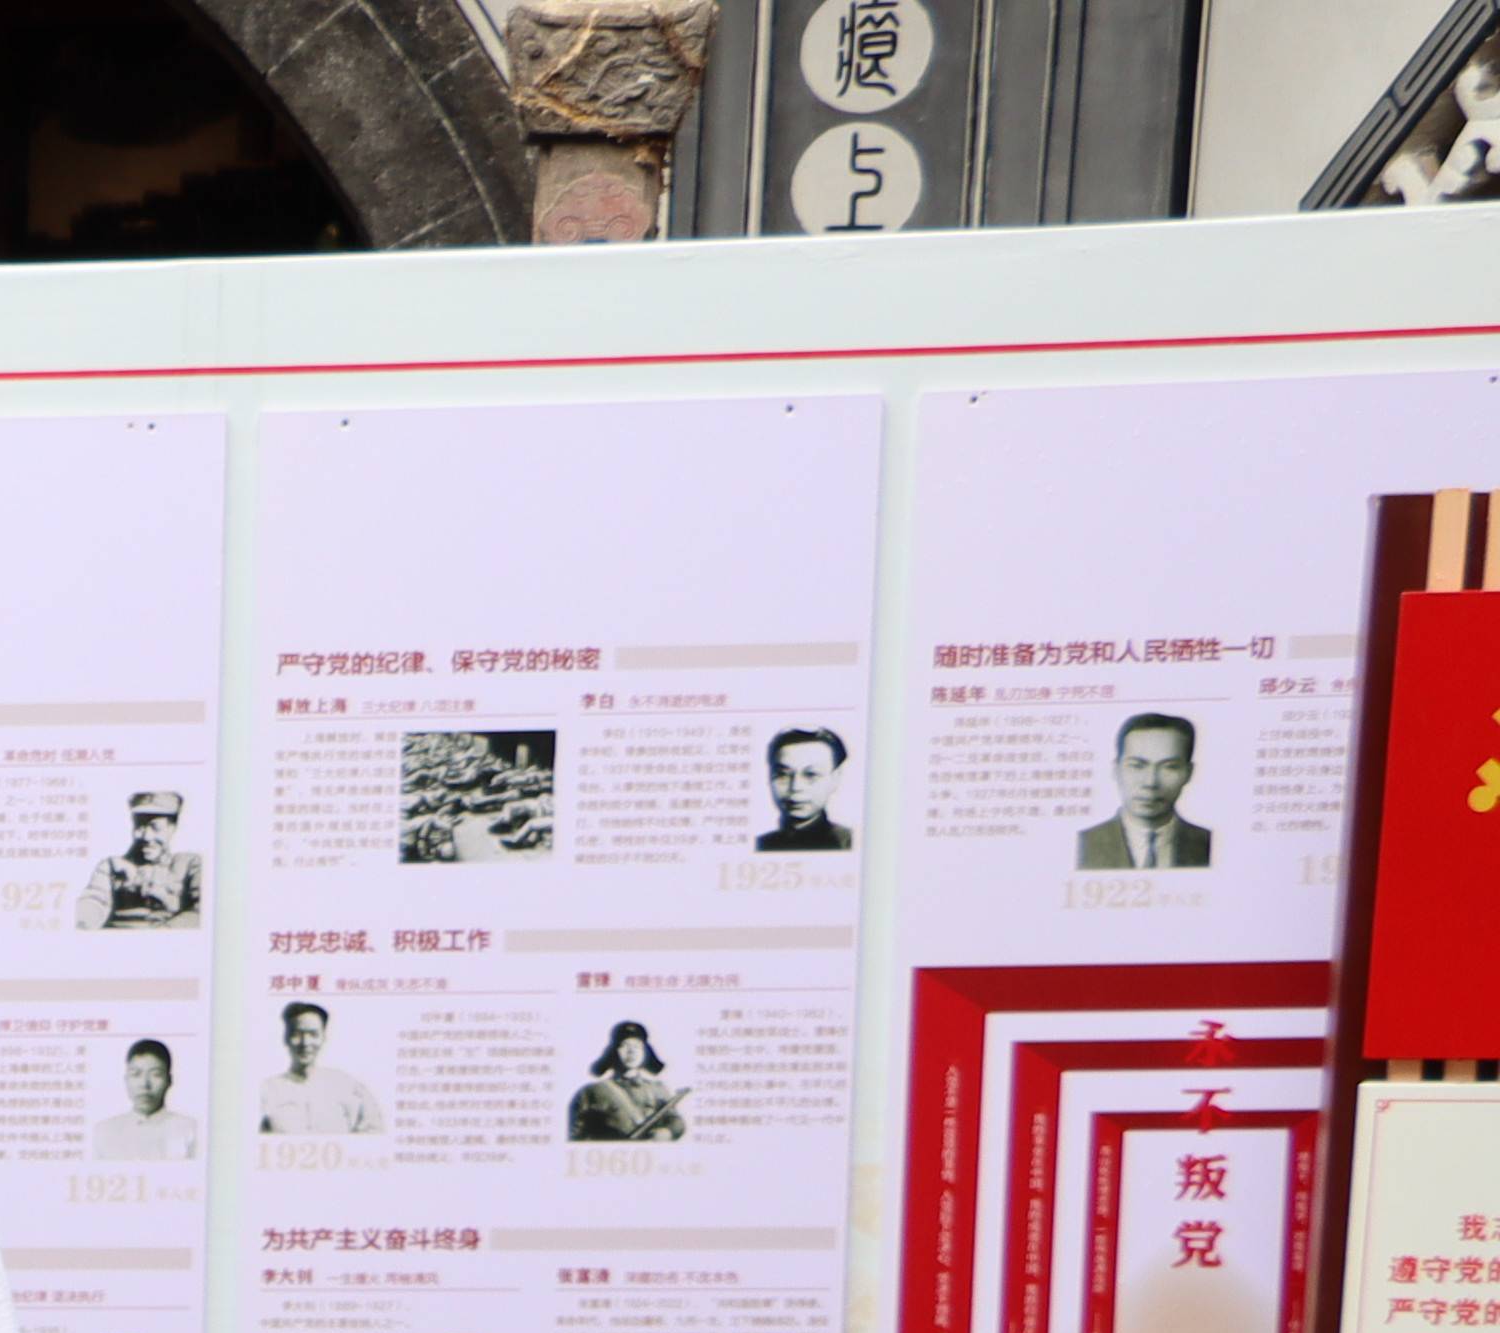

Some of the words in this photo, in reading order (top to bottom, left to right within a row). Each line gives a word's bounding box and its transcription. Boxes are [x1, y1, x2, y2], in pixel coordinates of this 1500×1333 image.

[274, 646, 603, 677] 严守党的纪律、保守党的秘密
[932, 635, 1276, 669] 随时准备为党和人民牺牲一切
[716, 862, 804, 892] 1925
[1061, 879, 1154, 910] 1922
[268, 929, 493, 955] 对党忠诚、积极工作
[257, 1141, 345, 1171] 1920
[1170, 1019, 1240, 1270] 永不叛党
[565, 1149, 649, 1178] 1960
[65, 1175, 149, 1204] 1921
[262, 1228, 482, 1252] 为共产主义奋斗终身
[1457, 1213, 1500, 1243] 我
